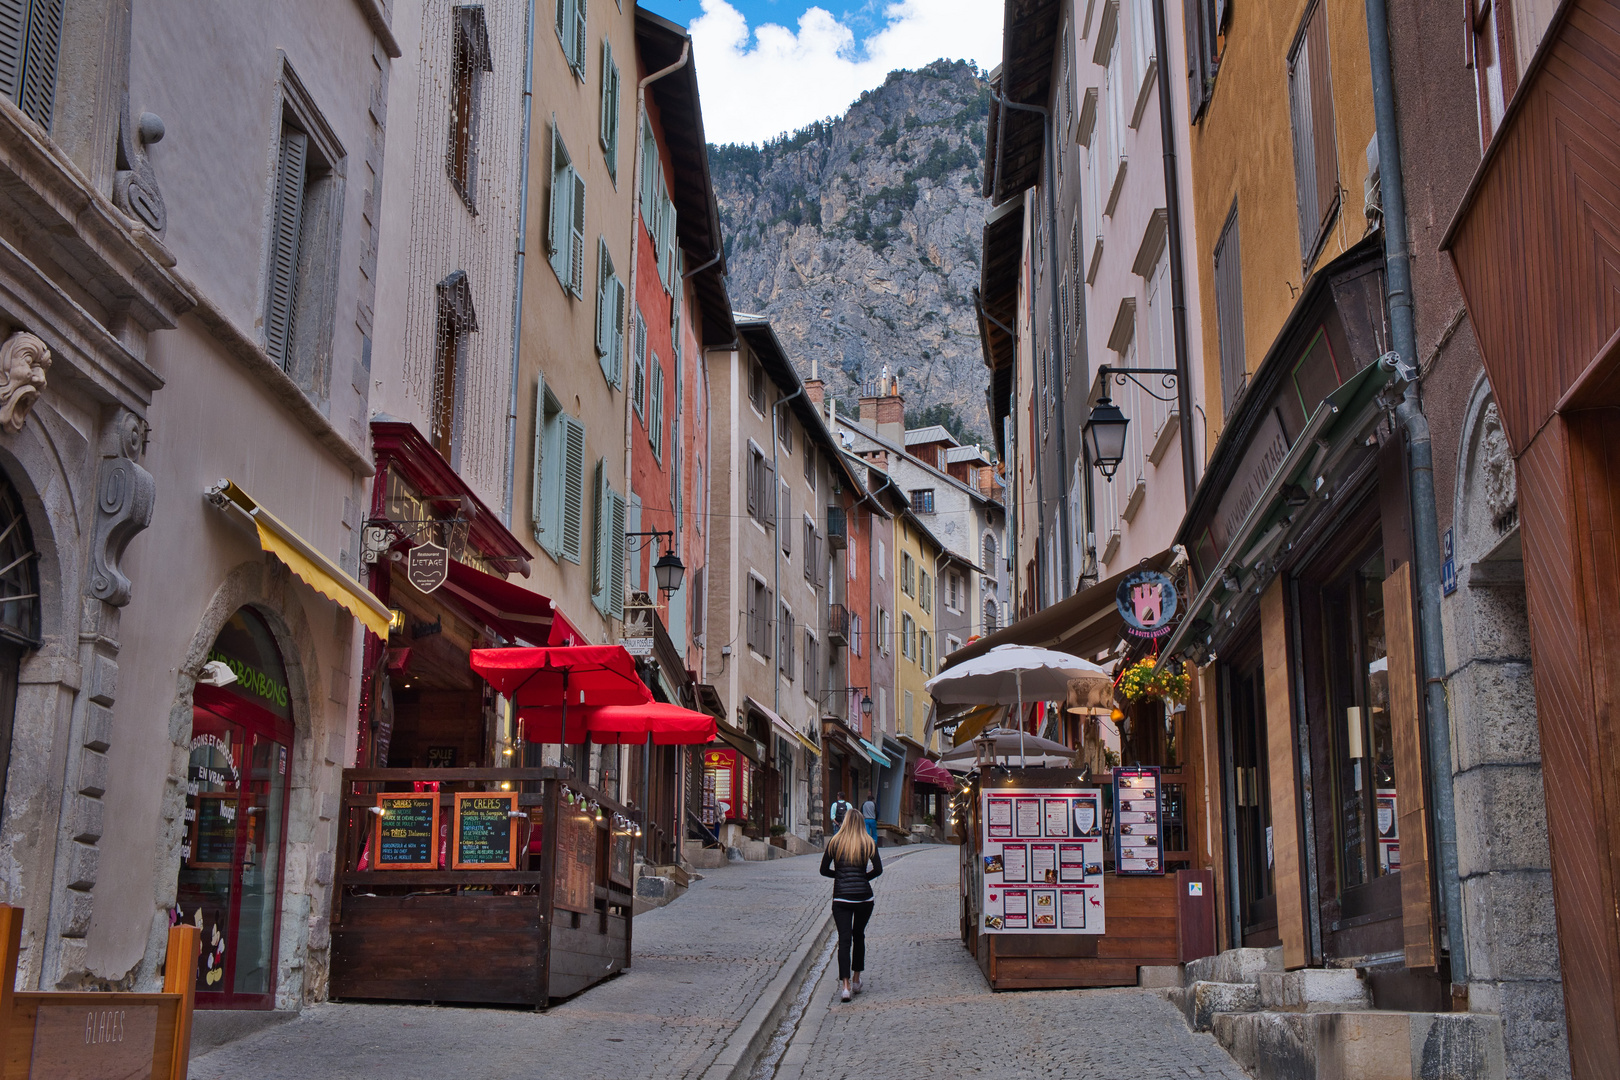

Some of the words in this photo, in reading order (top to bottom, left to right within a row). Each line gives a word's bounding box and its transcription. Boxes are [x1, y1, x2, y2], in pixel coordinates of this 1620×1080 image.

[1253, 433, 1286, 491] VINTAGE
[412, 558, 444, 567] L'ETAGE
[208, 734, 216, 747] ET
[199, 766, 208, 780] EN
[208, 769, 224, 786] VRAC
[220, 800, 236, 824] Nougat
[462, 800, 471, 809] Nos
[86, 1010, 125, 1044] GLACES
